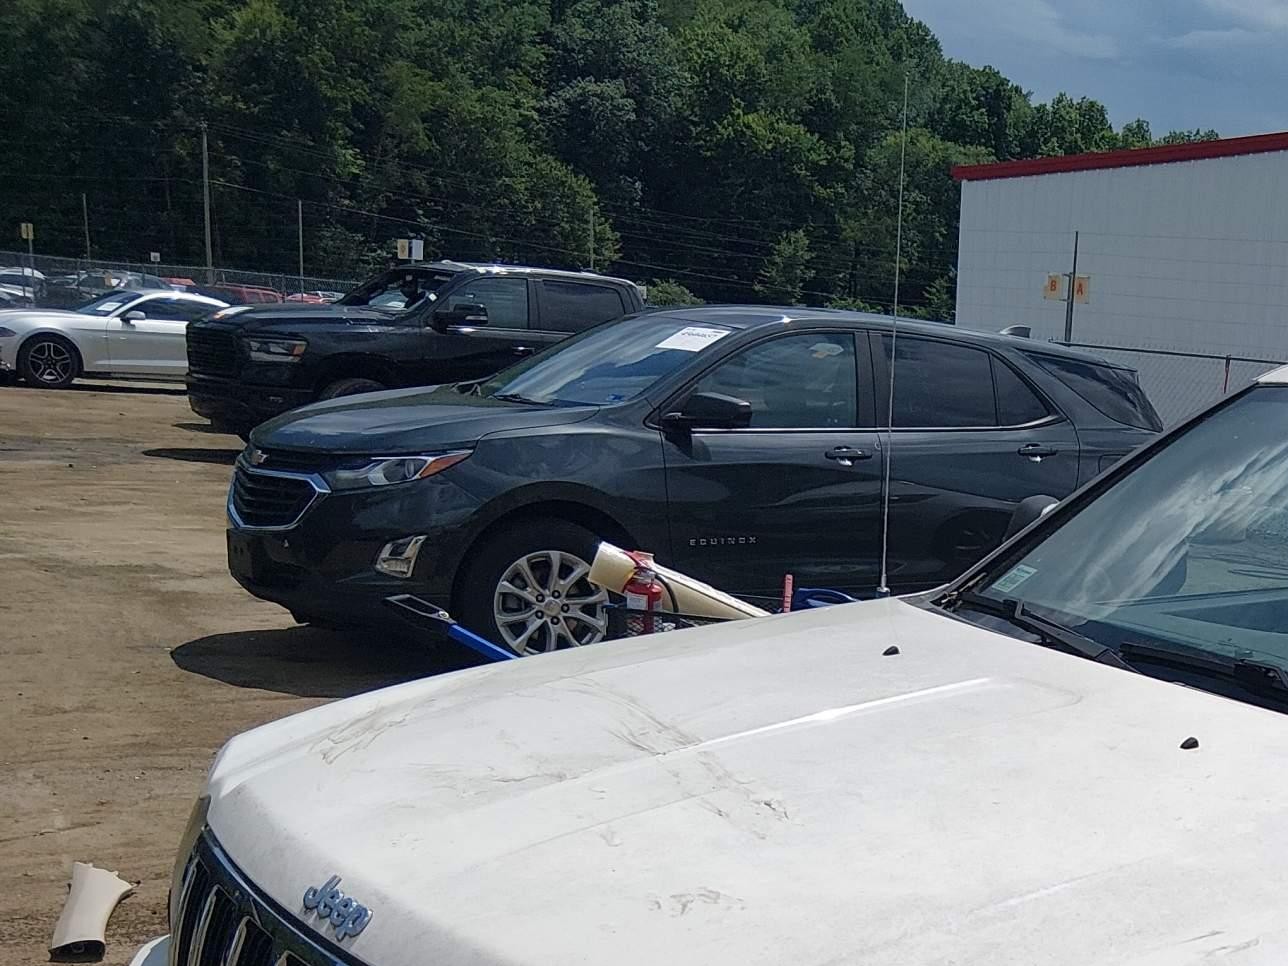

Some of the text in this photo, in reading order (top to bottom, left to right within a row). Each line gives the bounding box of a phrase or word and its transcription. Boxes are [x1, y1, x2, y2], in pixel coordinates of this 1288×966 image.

[1050, 279, 1057, 292] B
[1076, 282, 1084, 296] A
[689, 536, 757, 546] EQUINOX
[303, 874, 374, 942] Jeep
